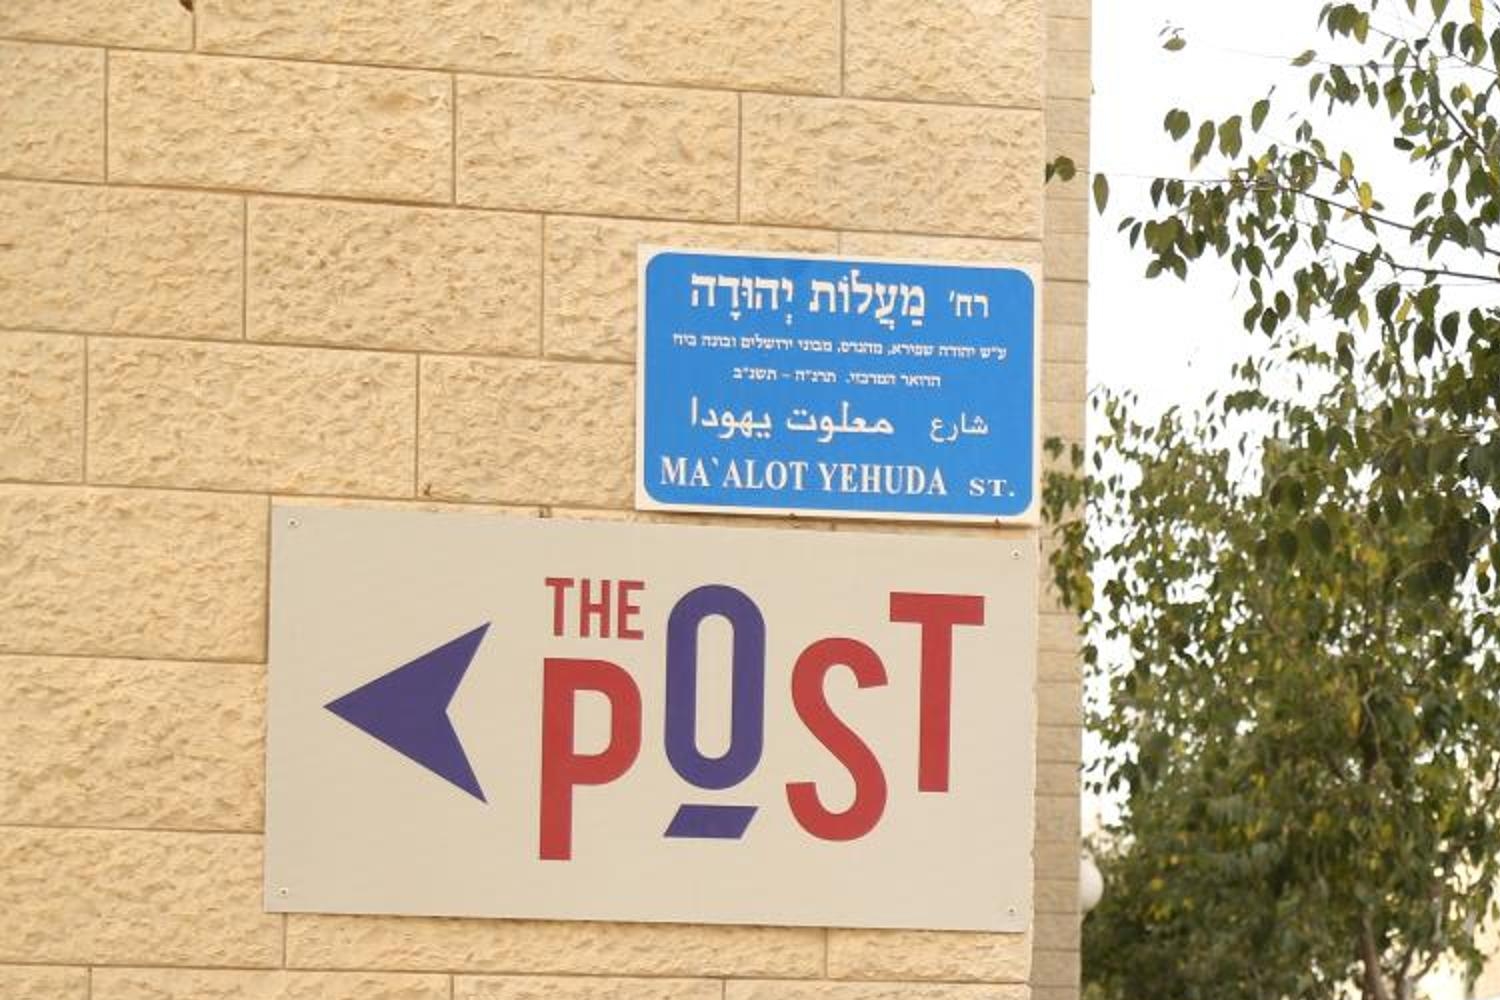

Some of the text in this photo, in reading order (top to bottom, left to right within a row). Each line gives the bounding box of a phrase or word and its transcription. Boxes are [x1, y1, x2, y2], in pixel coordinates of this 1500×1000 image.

[741, 333, 793, 351] ירושלים
[691, 396, 989, 443] شارع معلوت يهودا
[817, 463, 947, 496] YEHUDA
[968, 478, 1016, 498] ST.
[545, 577, 645, 640] THE
[539, 583, 985, 861] POST
